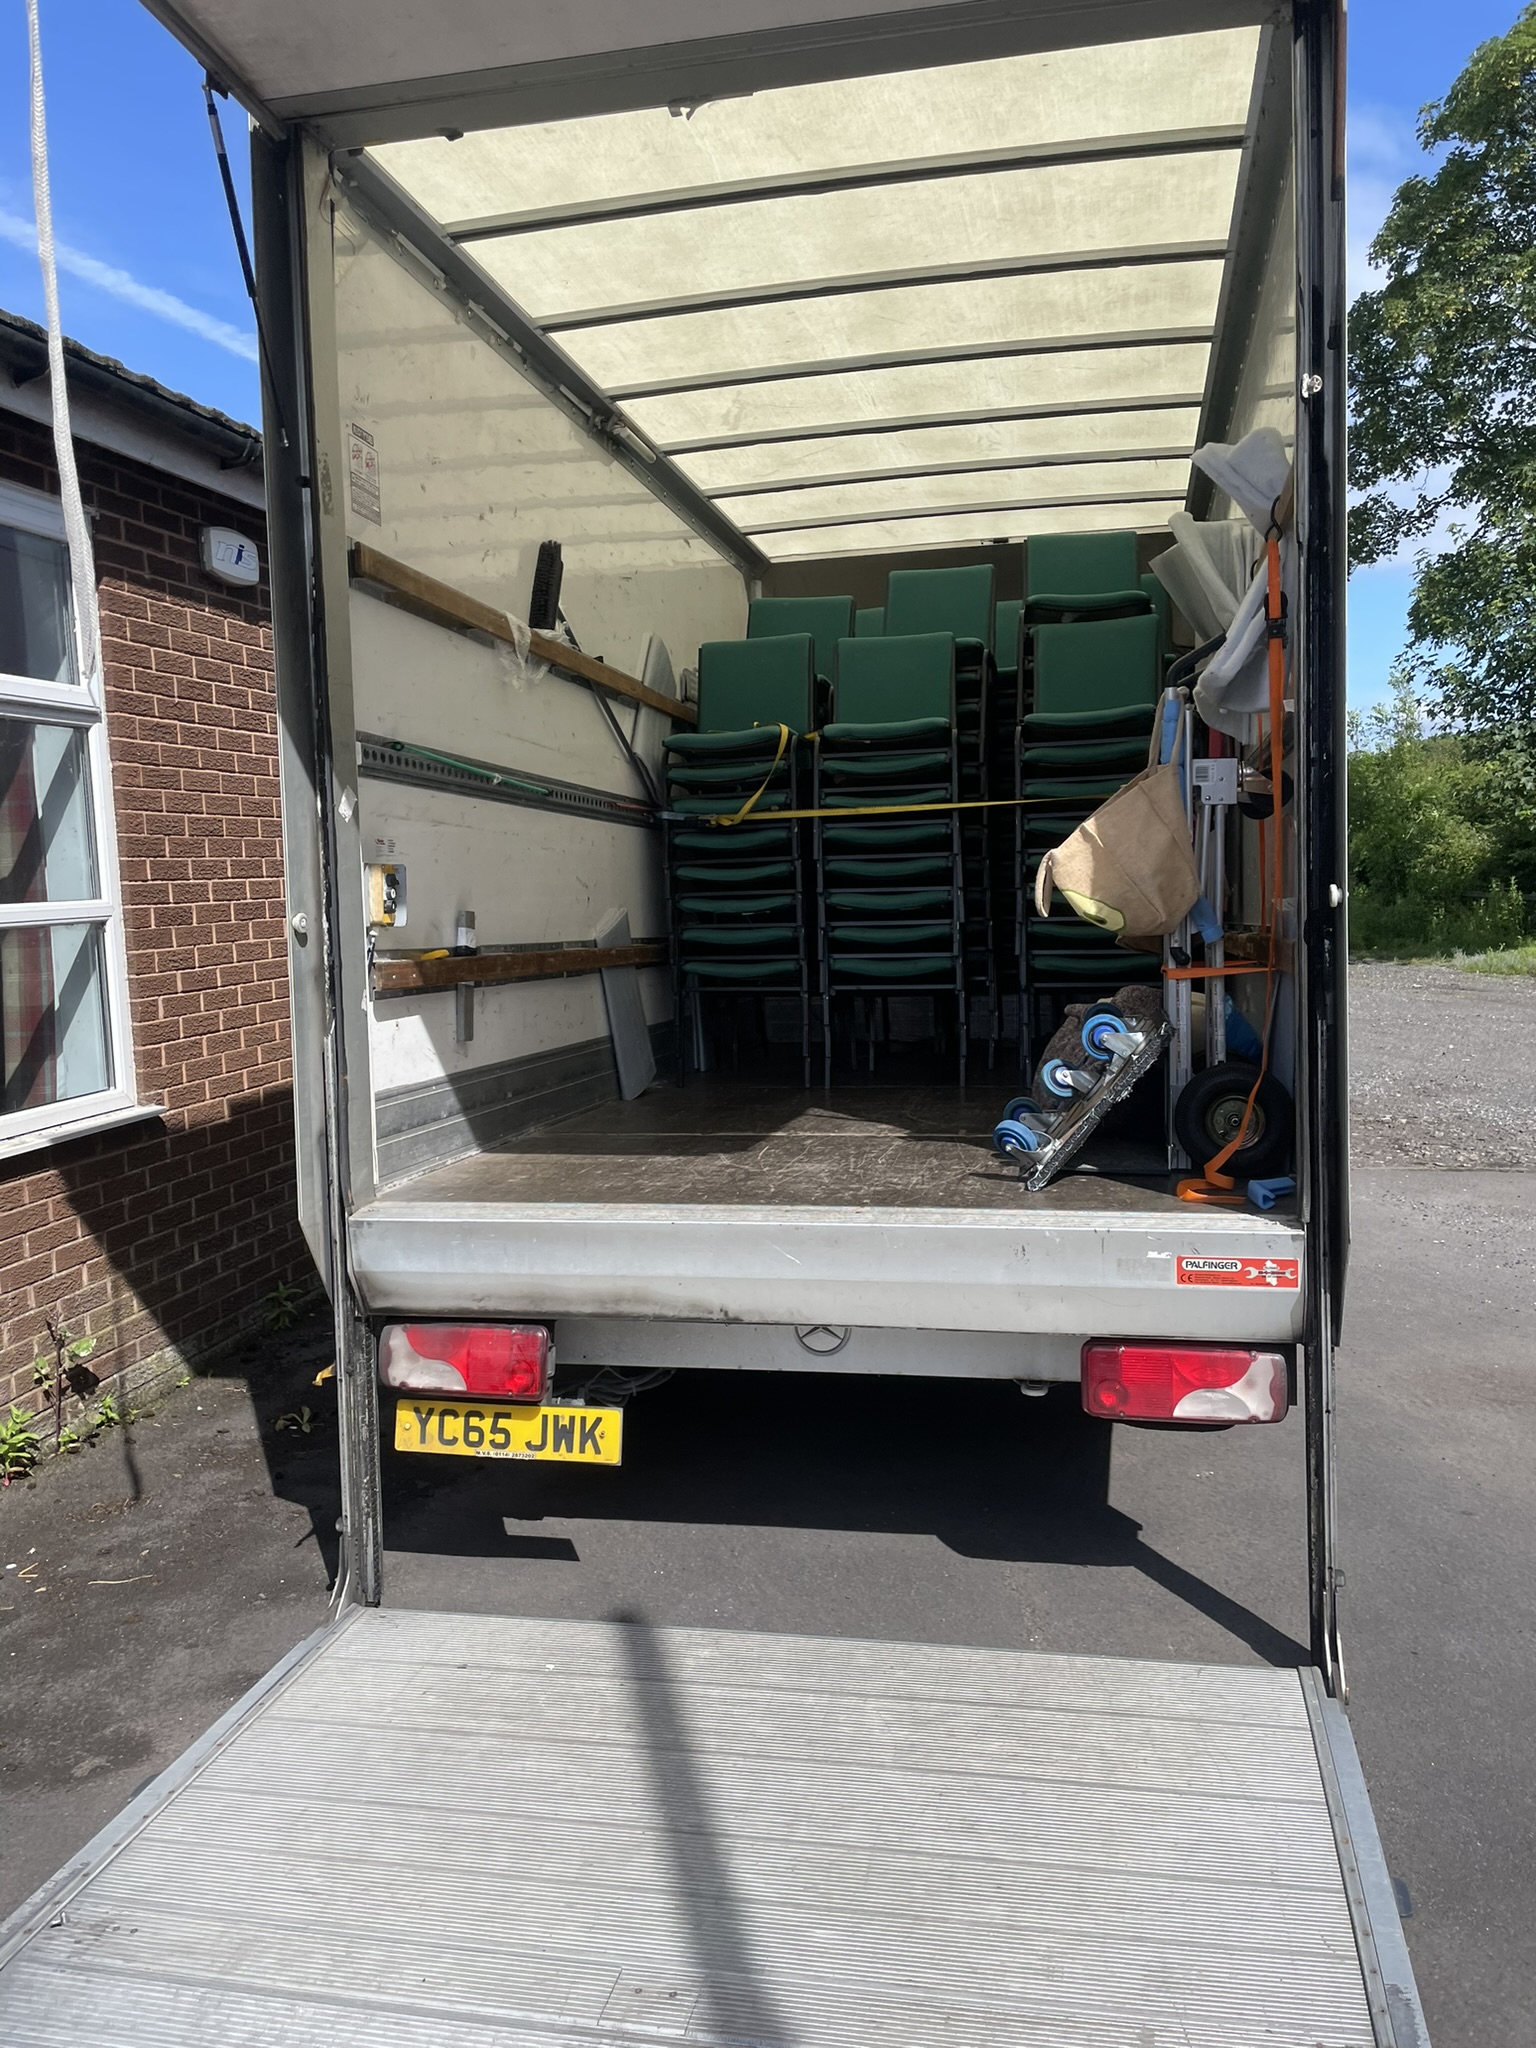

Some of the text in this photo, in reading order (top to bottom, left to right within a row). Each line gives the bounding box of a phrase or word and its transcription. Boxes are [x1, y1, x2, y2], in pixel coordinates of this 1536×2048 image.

[1185, 1260, 1239, 1270] PALFINGER
[413, 1406, 603, 1455] YC65 JWK
